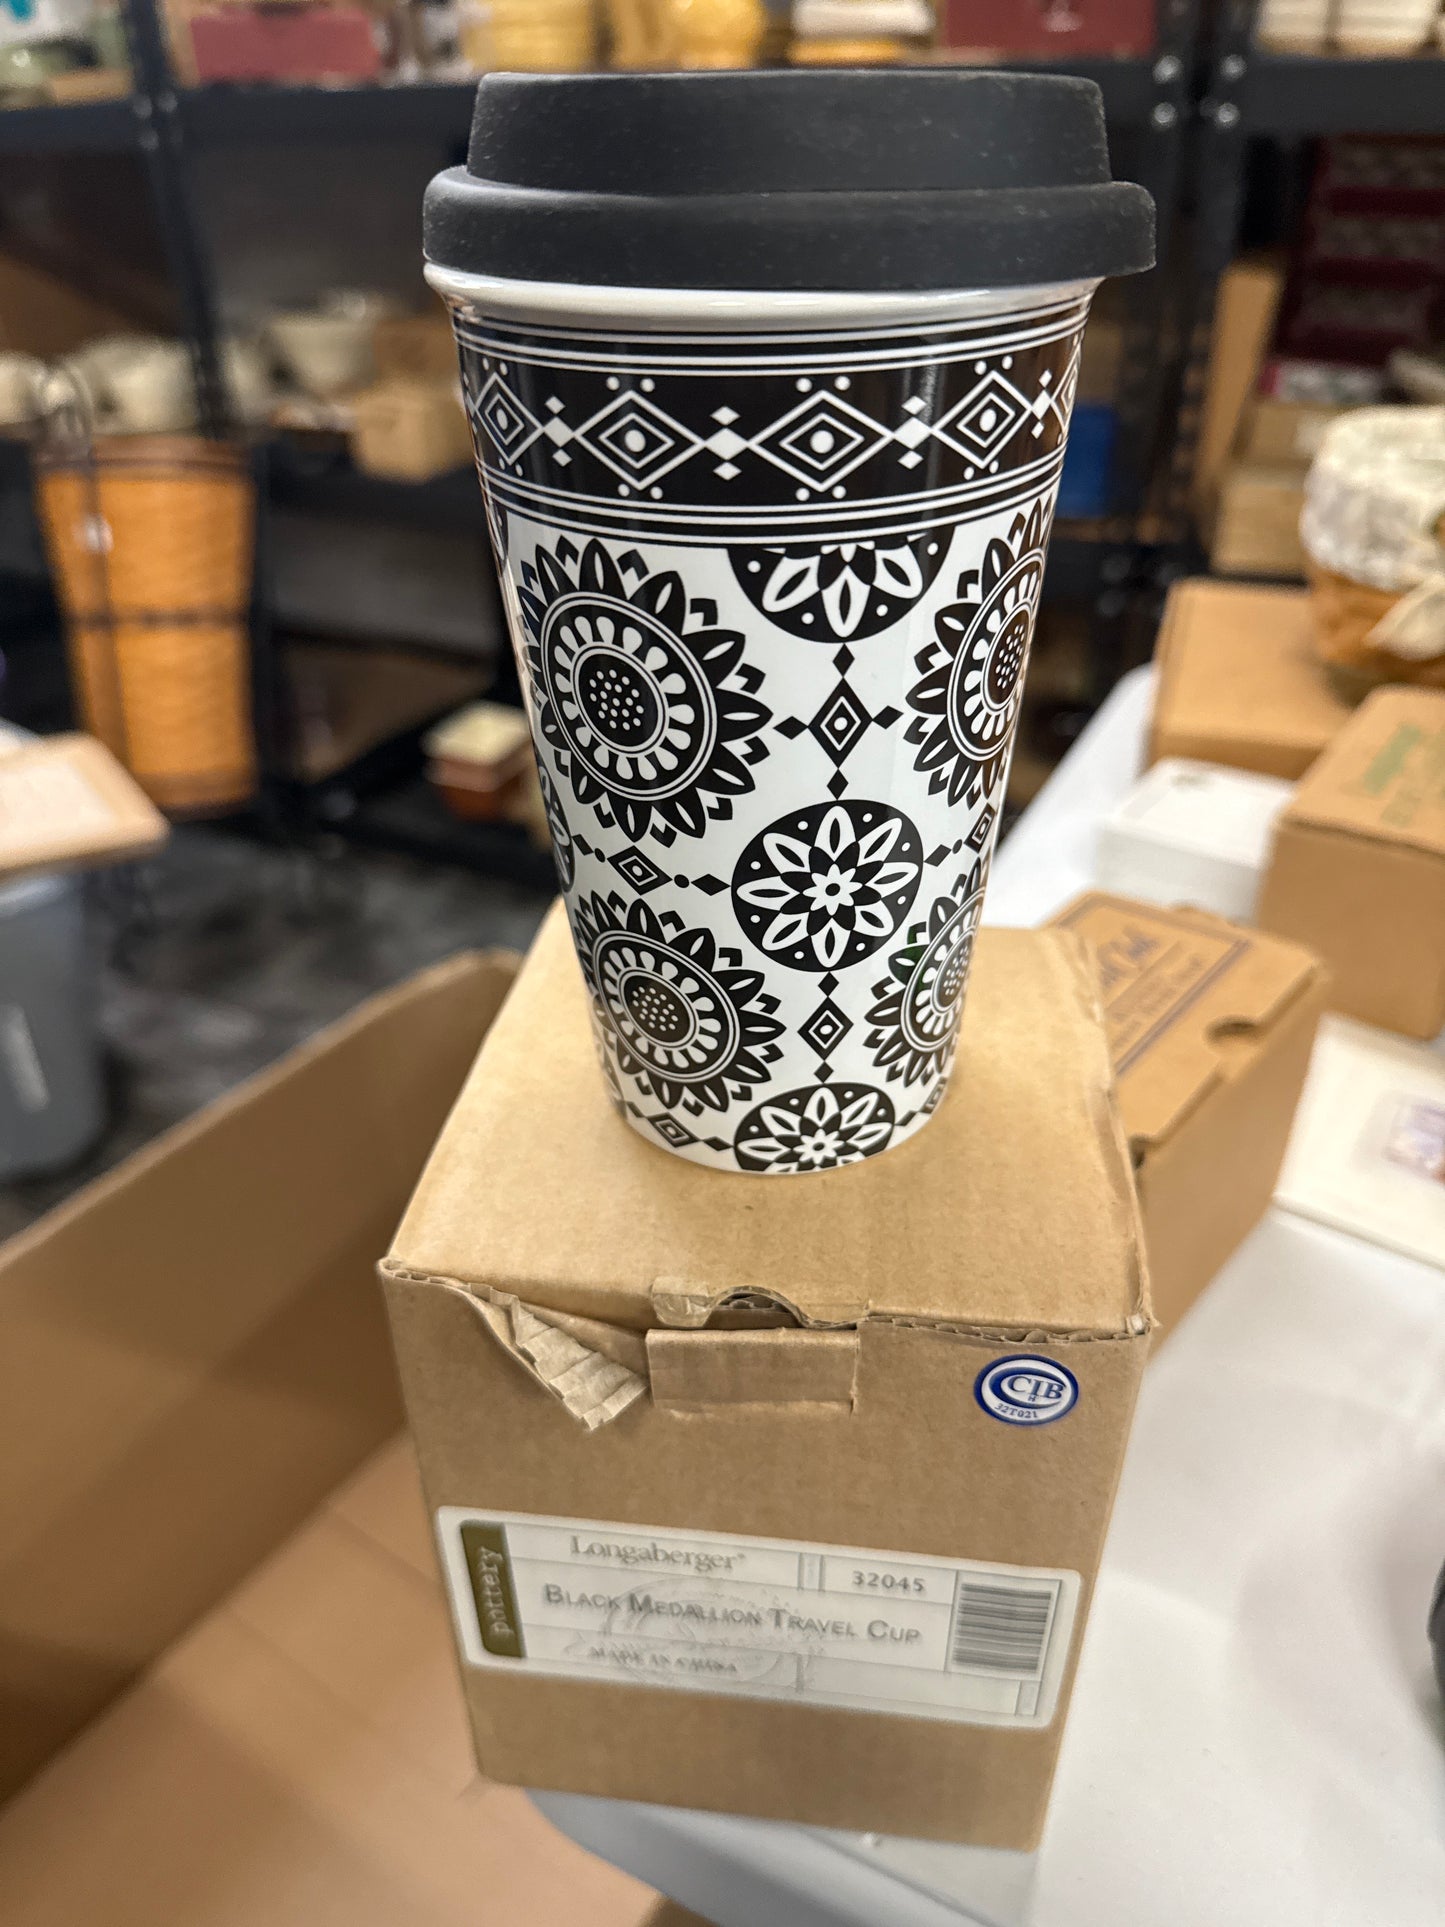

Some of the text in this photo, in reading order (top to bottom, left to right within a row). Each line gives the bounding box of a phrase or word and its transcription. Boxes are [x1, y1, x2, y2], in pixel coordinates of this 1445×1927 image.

[1007, 1375, 1064, 1399] CIB
[852, 1570, 926, 1593] 32045
[477, 1545, 518, 1643] pottery
